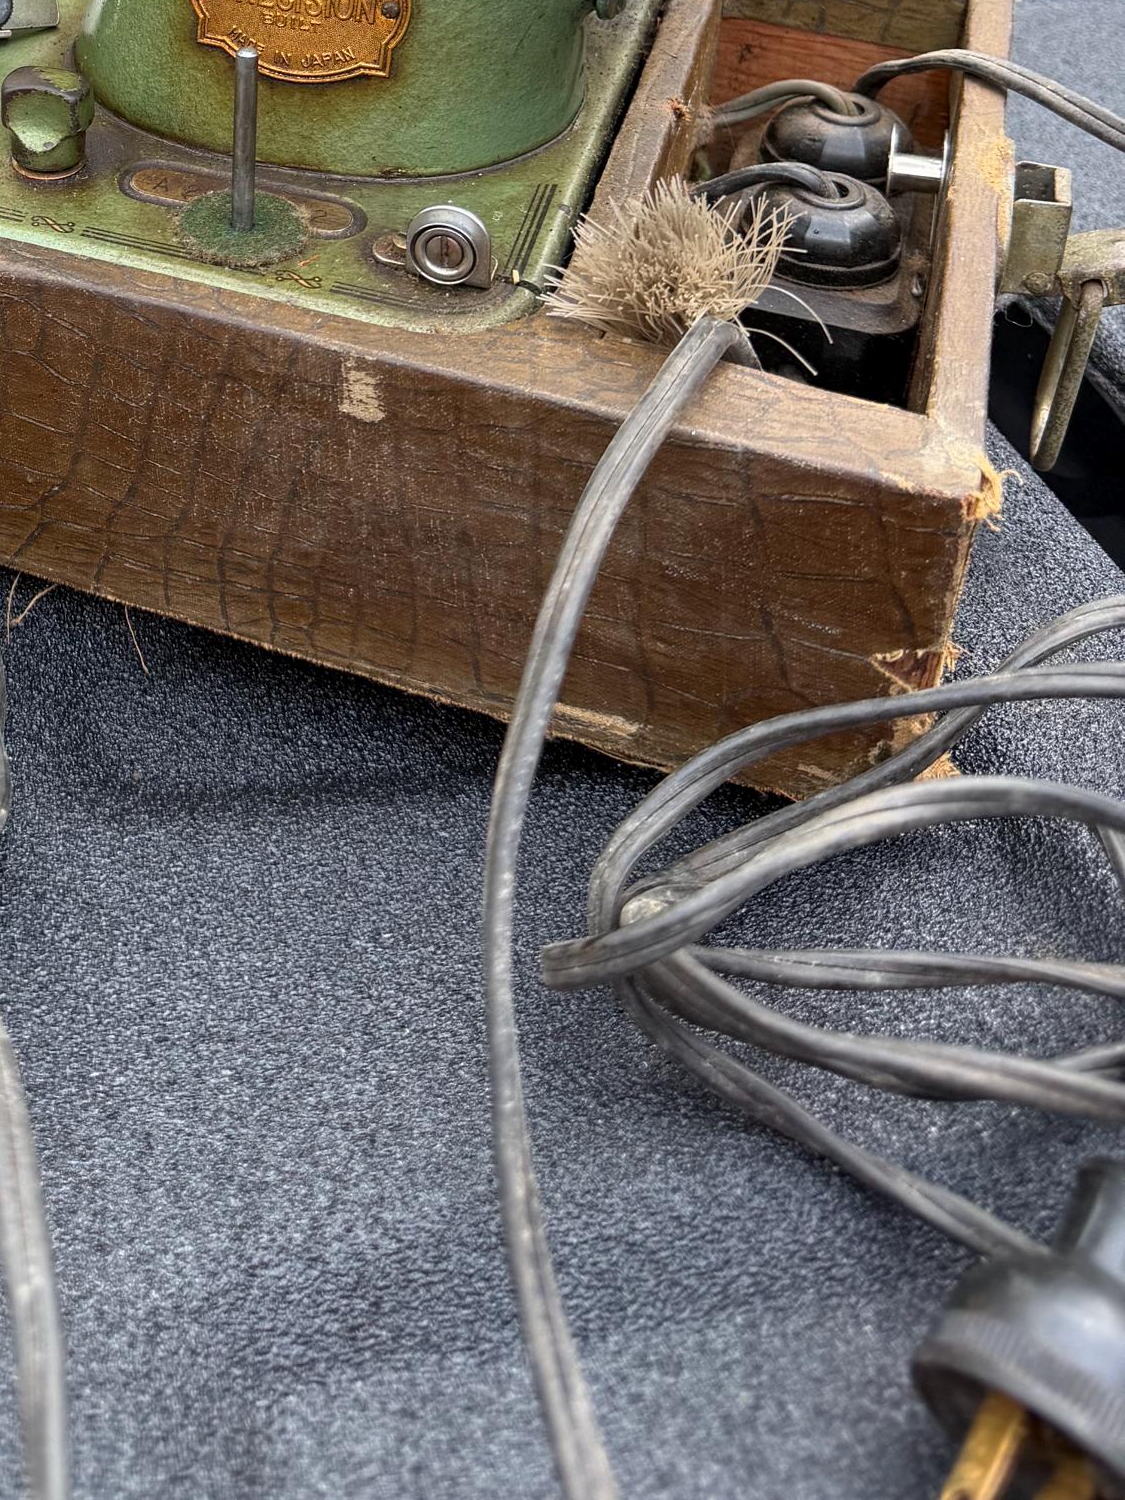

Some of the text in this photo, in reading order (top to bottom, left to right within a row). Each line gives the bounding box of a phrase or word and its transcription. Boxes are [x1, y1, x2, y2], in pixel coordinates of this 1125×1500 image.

[261, 10, 322, 33] BUILT
[274, 50, 292, 67] IN
[301, 46, 357, 68] JAPAN
